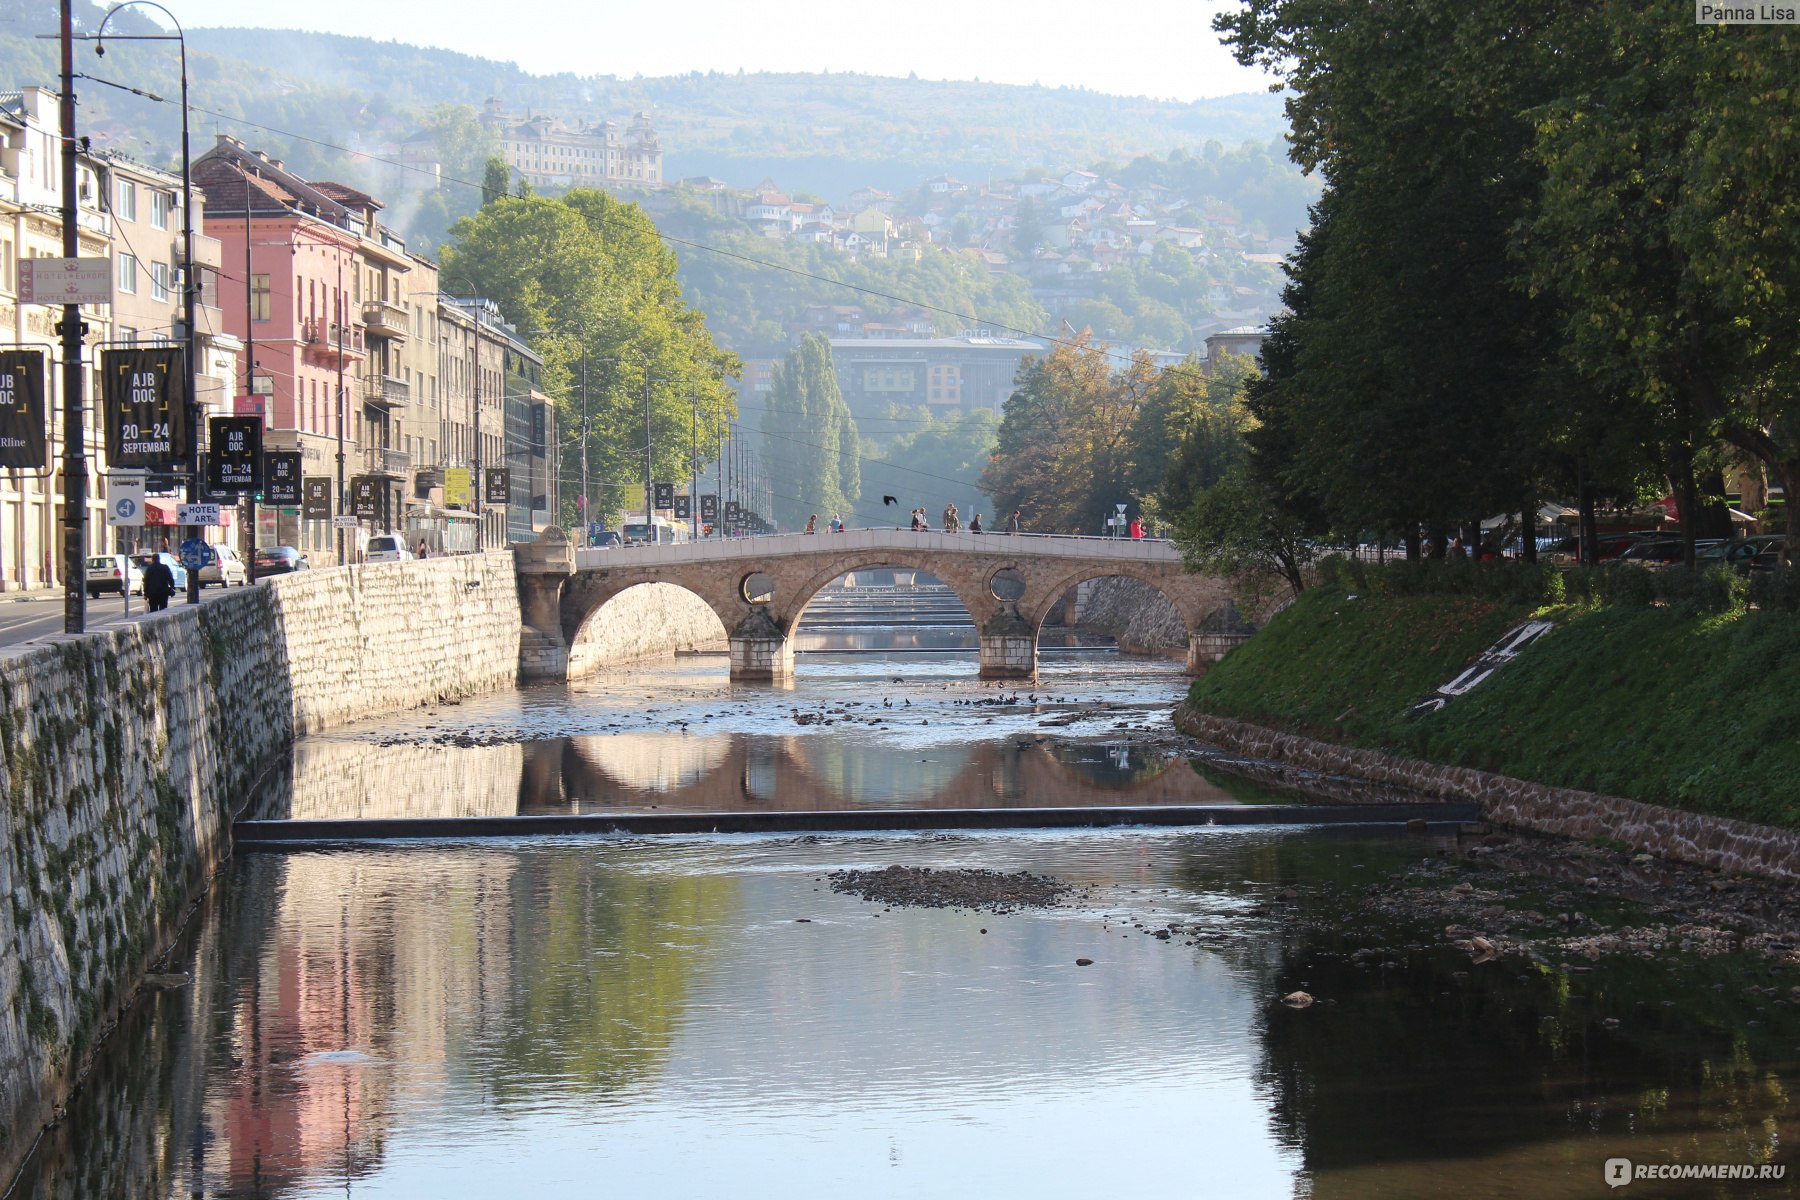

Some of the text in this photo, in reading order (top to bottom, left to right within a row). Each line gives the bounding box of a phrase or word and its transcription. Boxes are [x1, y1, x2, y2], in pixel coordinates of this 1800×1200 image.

[132, 373, 155, 387] AJB
[132, 389, 156, 402] DOC
[228, 432, 243, 441] AJB
[123, 442, 170, 454] SEPTEMBAR
[228, 442, 244, 451] DOC
